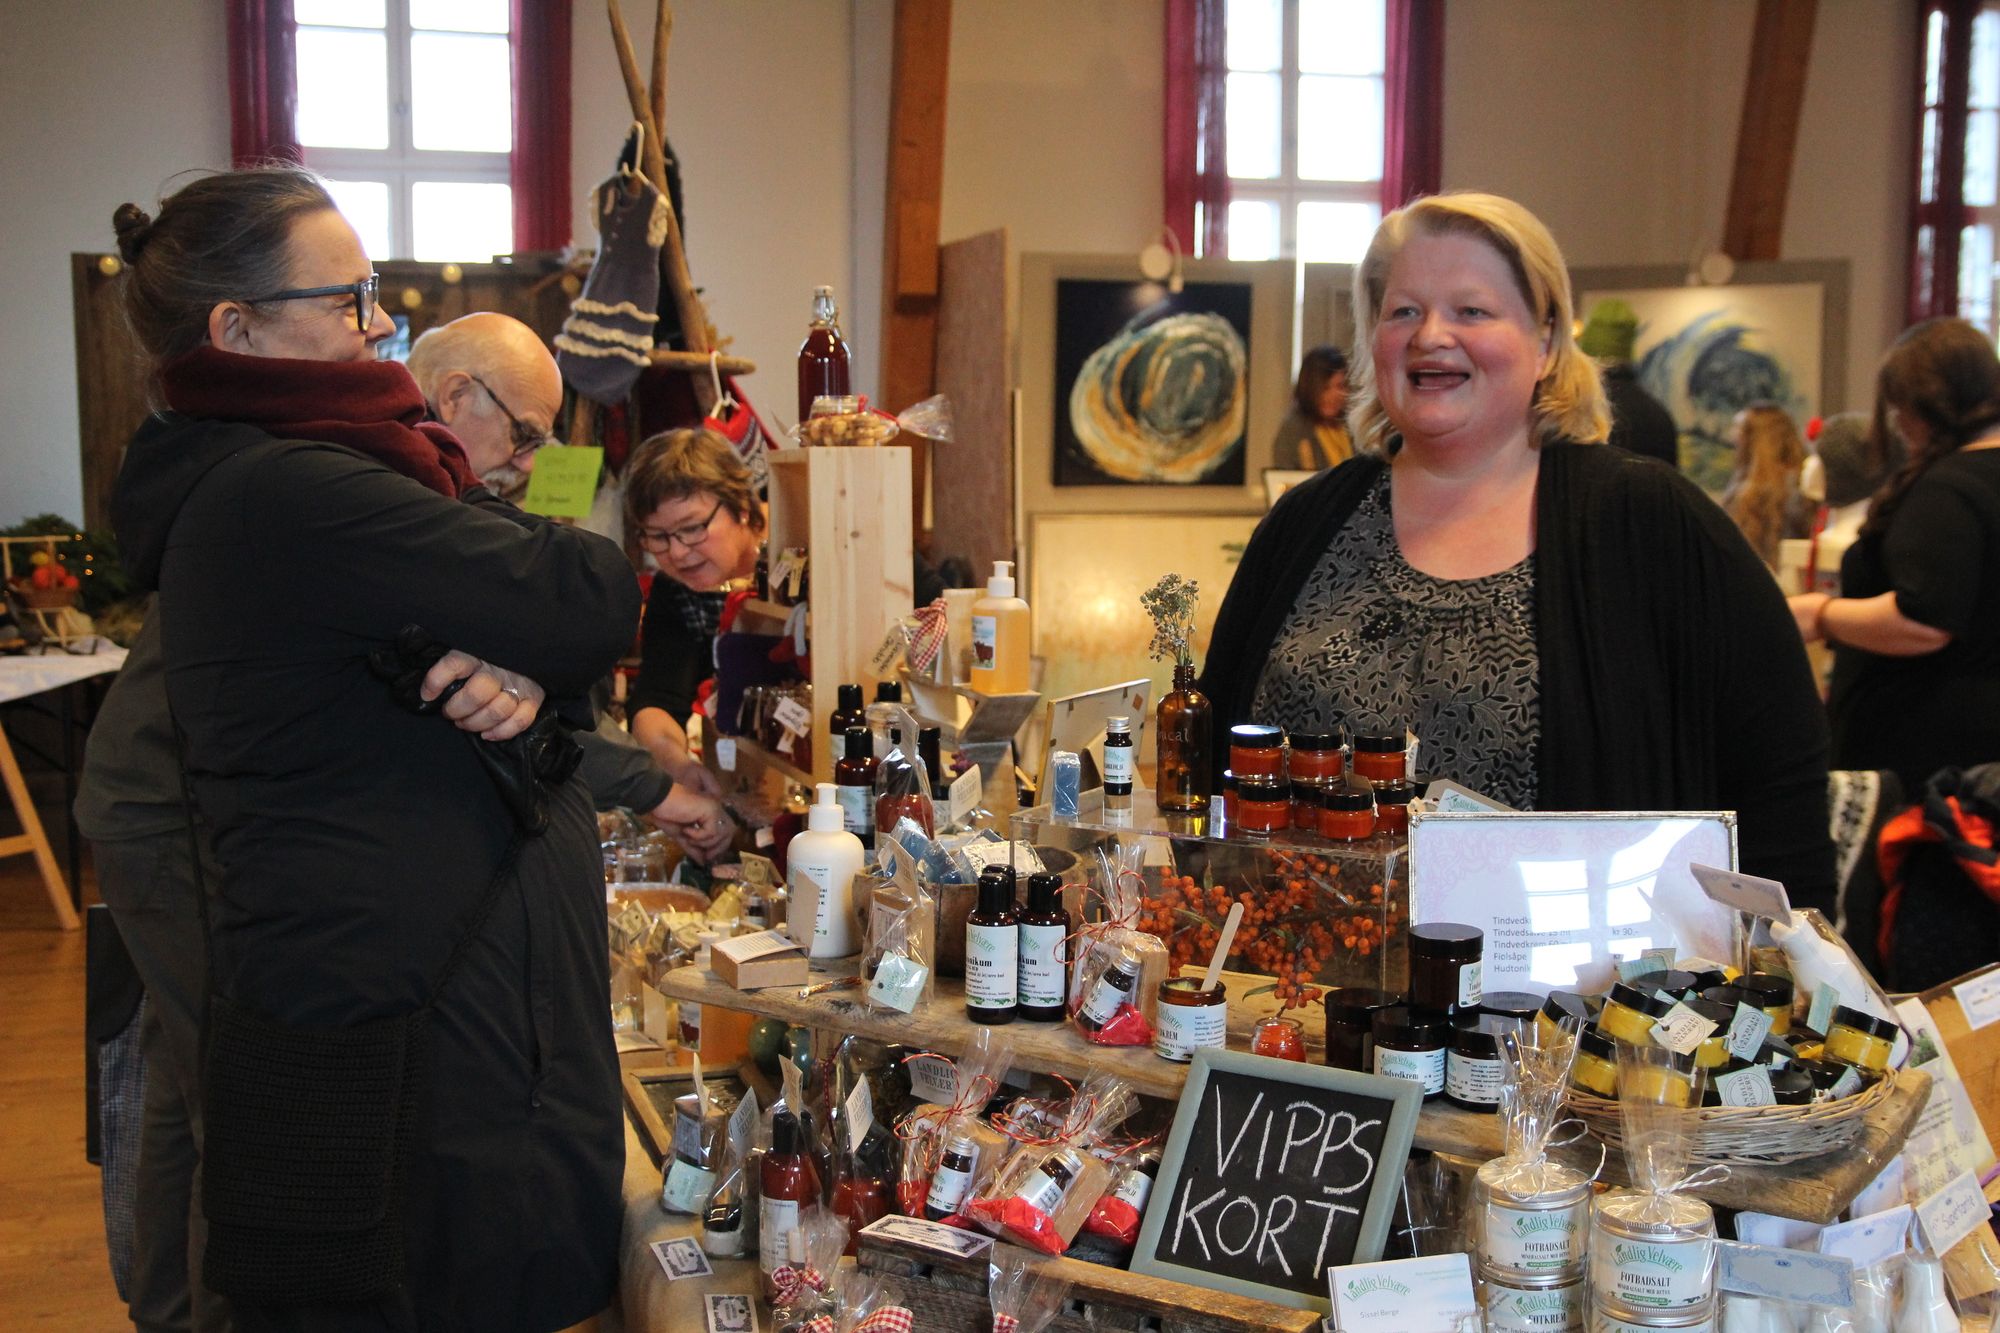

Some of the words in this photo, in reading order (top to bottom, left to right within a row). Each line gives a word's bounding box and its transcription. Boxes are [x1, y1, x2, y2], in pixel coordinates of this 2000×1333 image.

[1494, 965, 1531, 973] Hudtonik
[920, 1071, 953, 1090] VELVÆR
[1216, 1084, 1382, 1195] VIPPS
[1171, 1177, 1360, 1280] KORT
[1511, 1216, 1549, 1238] Landlig
[1524, 1240, 1570, 1251] FOTBADSALT
[1610, 1245, 1647, 1266] Landlig
[1647, 1245, 1683, 1273] Velvære
[1343, 1276, 1378, 1302] Landlig
[1377, 1274, 1412, 1296] Velvære
[1620, 1271, 1671, 1287] FOTBADSALT
[1512, 1295, 1549, 1318] Landlig
[1528, 1312, 1567, 1325] FOTKREM
